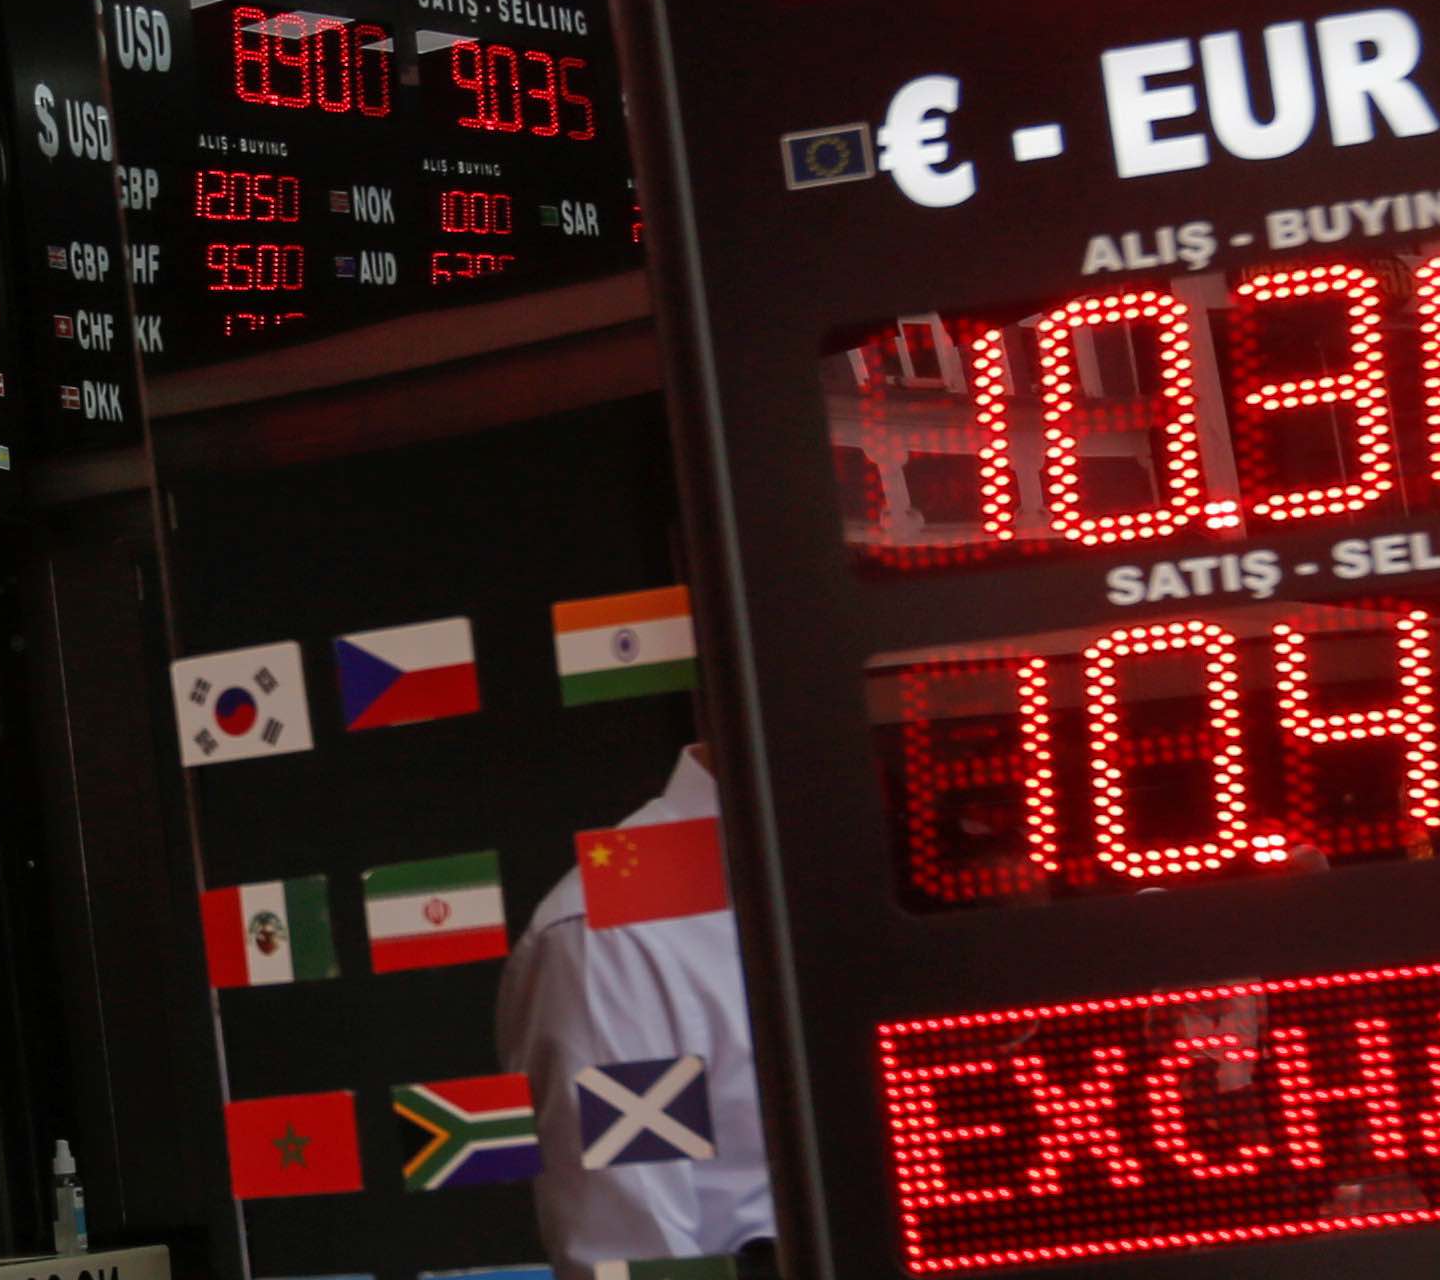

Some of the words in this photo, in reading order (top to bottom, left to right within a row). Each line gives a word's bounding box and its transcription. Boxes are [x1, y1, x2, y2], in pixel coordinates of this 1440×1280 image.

[113, 3, 171, 73] USD
[878, 74, 976, 208] €
[1103, 6, 1438, 178] EUR
[66, 99, 114, 162] USD
[352, 186, 395, 224] NOK
[560, 200, 599, 237] SAR
[70, 241, 110, 283] GBP
[1083, 211, 1215, 275] ALIŞ
[126, 245, 160, 284] HF
[359, 252, 397, 286] AUD
[76, 310, 114, 351] CHF
[133, 315, 163, 352] KK
[82, 380, 124, 422] DKK
[1108, 548, 1279, 607] SATIŞ
